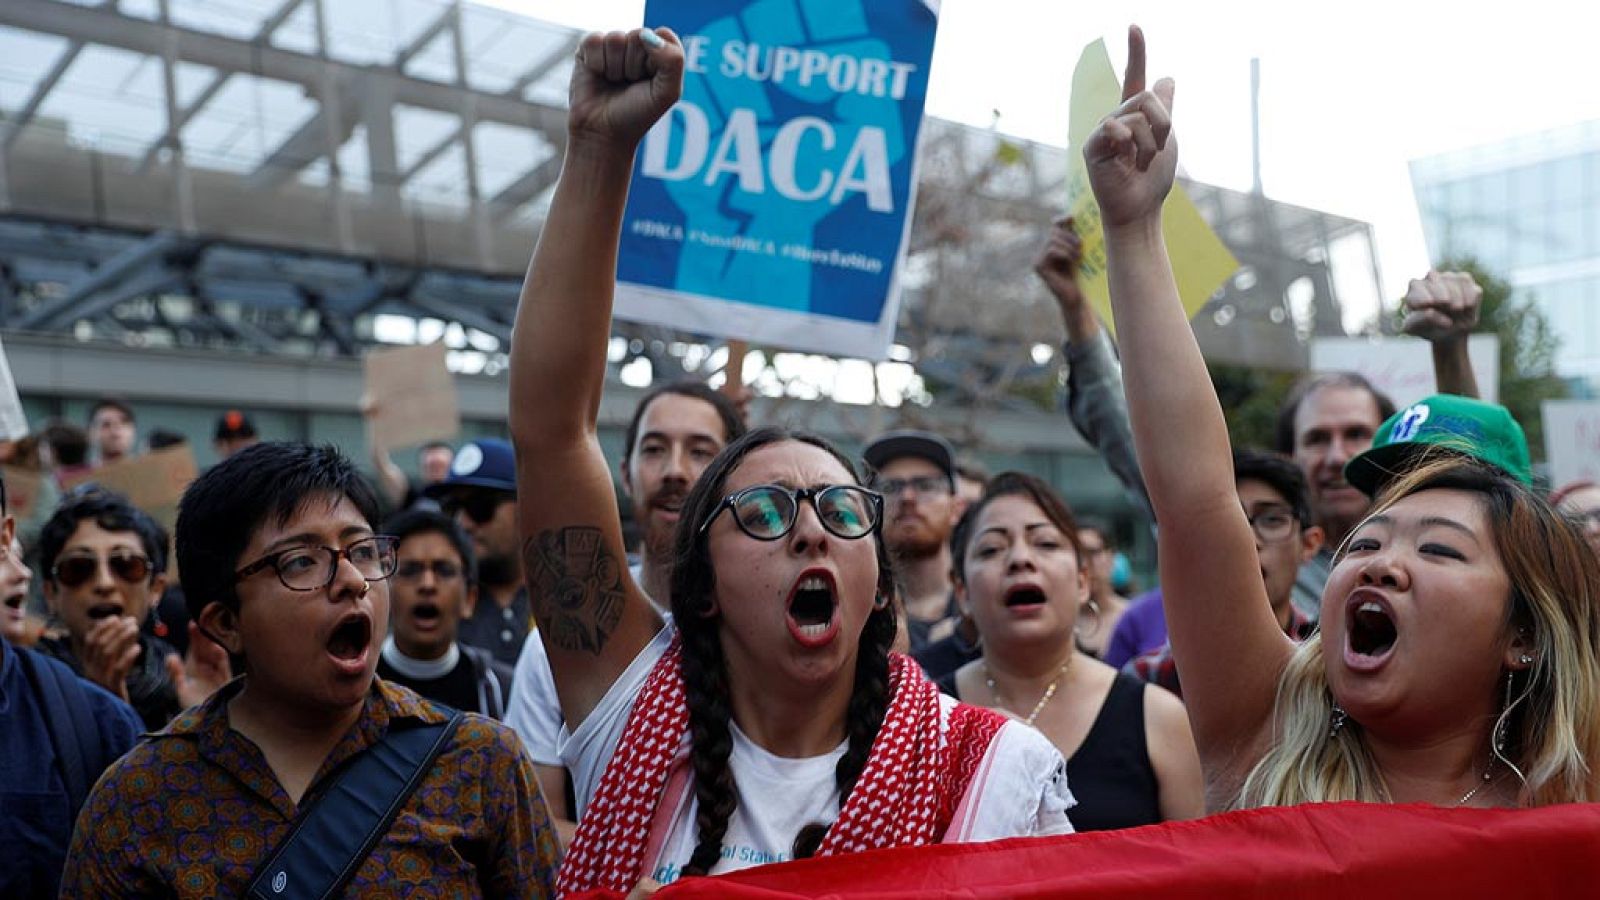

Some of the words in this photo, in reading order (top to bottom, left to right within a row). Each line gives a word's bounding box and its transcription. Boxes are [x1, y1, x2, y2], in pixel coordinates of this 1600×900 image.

[683, 36, 711, 73] E
[719, 39, 917, 100] SUPPORT
[641, 101, 894, 214] DACA
[632, 219, 684, 241] #DACA
[688, 228, 776, 255] #SaveDACA
